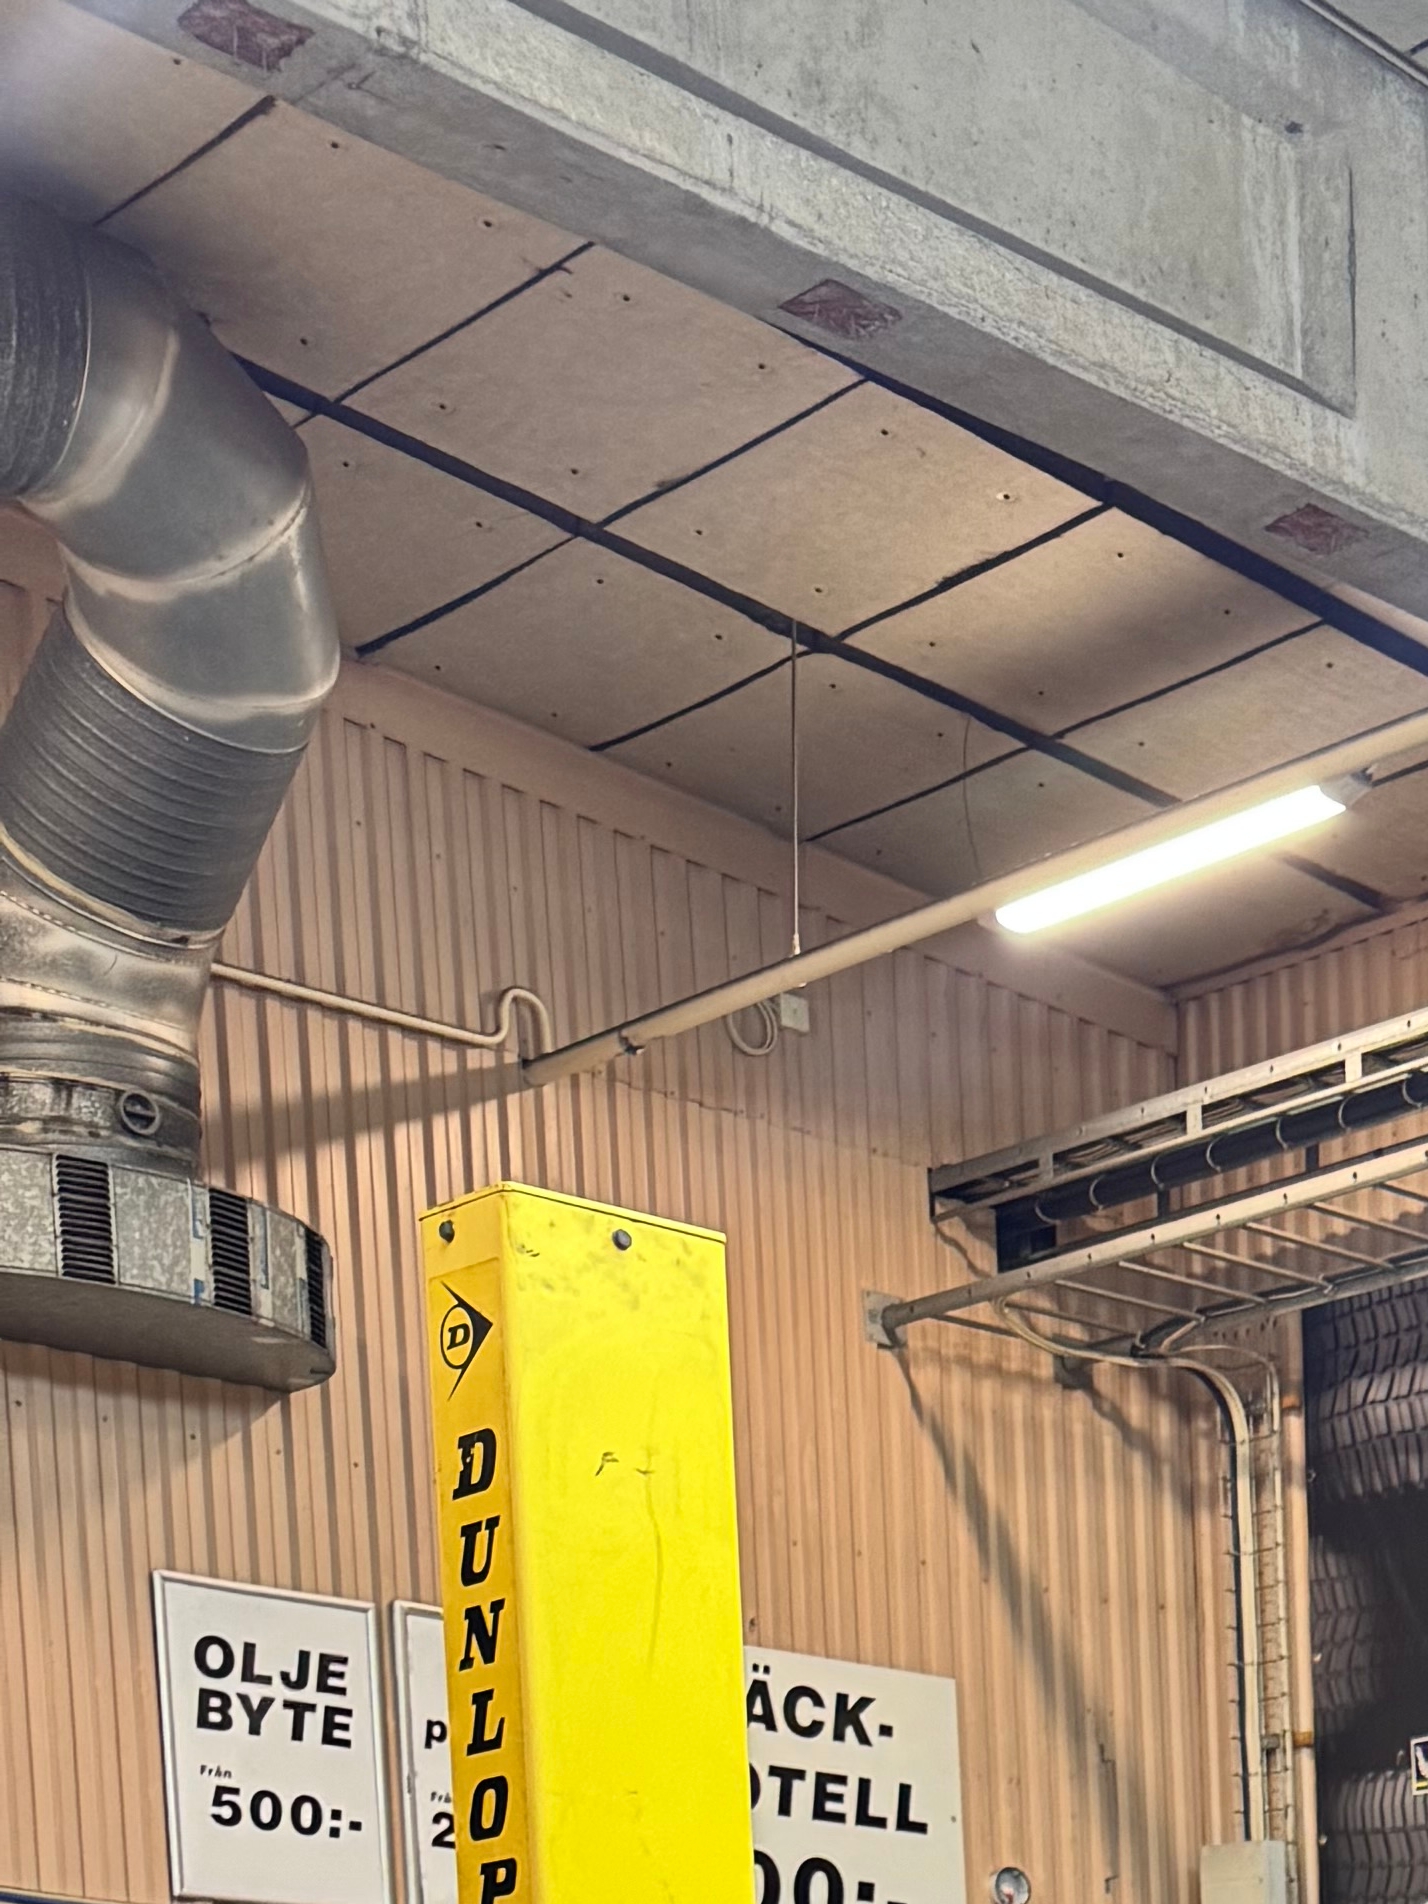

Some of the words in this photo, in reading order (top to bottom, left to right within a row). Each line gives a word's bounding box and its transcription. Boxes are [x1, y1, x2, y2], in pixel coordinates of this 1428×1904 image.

[194, 1635, 349, 1696] OLJE
[196, 1688, 353, 1749] BYTE
[746, 1663, 894, 1747] ÄCK-
[210, 1785, 363, 1838] 500:-
